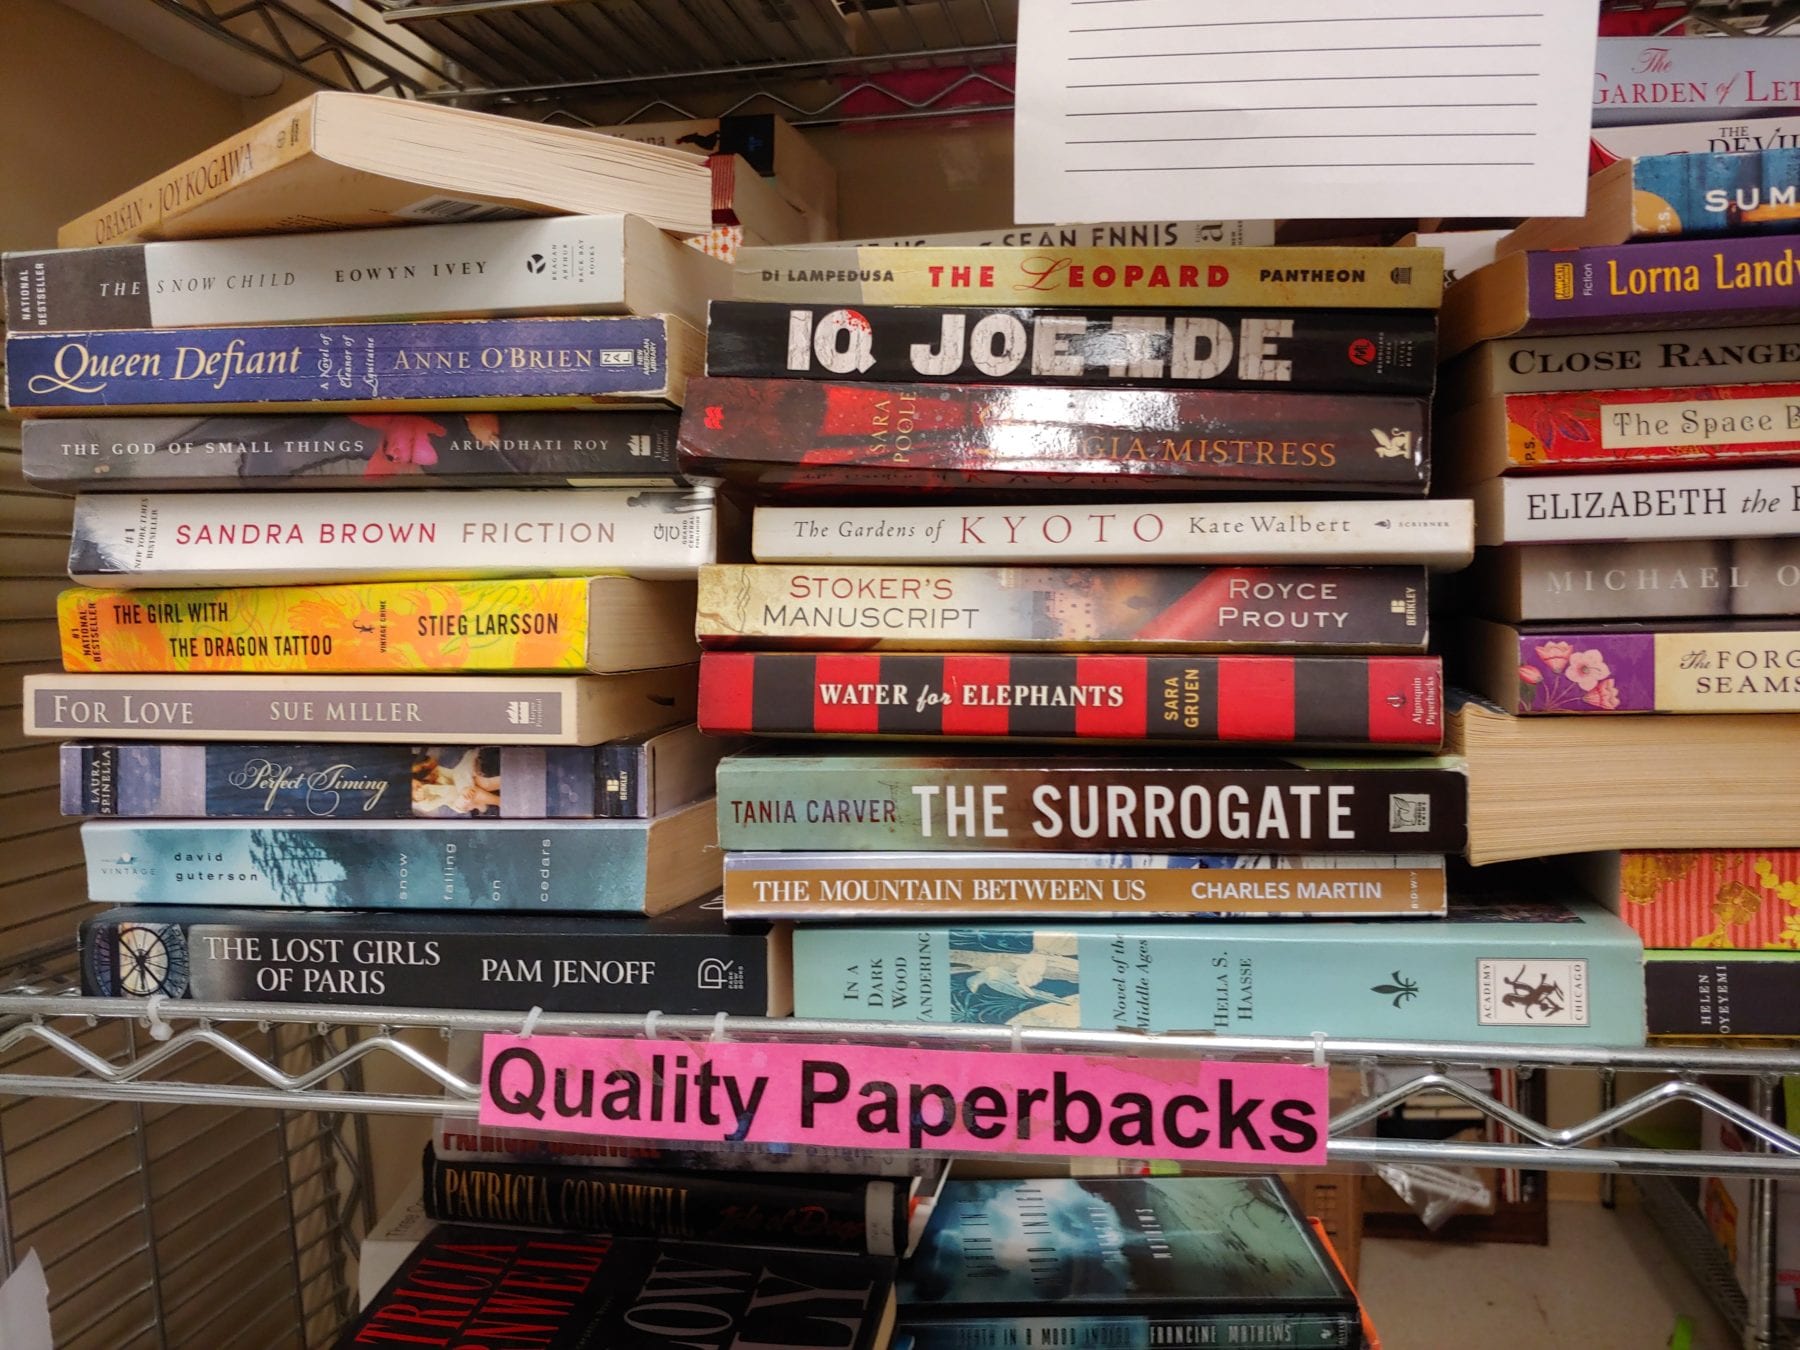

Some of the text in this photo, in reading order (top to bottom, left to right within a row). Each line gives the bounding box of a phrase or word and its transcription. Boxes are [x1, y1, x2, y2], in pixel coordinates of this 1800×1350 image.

[1632, 48, 1674, 74] The
[1716, 73, 1741, 105] of
[1719, 126, 1749, 138] THE
[95, 143, 254, 245] OBASAN JOY KOGAWA
[1704, 185, 1797, 212] SUM
[100, 271, 296, 297] THE SNOW CHILD
[335, 261, 489, 283] EOWYN IVEY
[788, 269, 895, 282] LAMPEDUSA
[928, 256, 1230, 292] THE LEOPARD
[1259, 269, 1366, 283] PANTHEON
[1582, 262, 1592, 297] Fiction
[1608, 259, 1700, 296] Lorna
[22, 268, 30, 321] NATIONAL
[37, 262, 46, 326] BESTSELLER
[393, 347, 593, 370] ANNE O'BRIEN
[786, 308, 877, 375] IQ
[909, 313, 1088, 378] JOE
[1508, 342, 1800, 375] CLOSE RANGE
[28, 339, 303, 394] Queen Defiant
[318, 333, 333, 390] A Novel of
[337, 334, 355, 388] Eleanor of
[362, 337, 378, 396] Aquitaine
[869, 399, 892, 456] SARA
[893, 391, 919, 464] POOLE
[1613, 408, 1773, 439] The Space
[61, 440, 365, 456] THE GOD OF SMALL THINGS
[450, 439, 610, 451] ARUNDHATI ROY
[1163, 438, 1337, 468] MISTRESS
[1524, 436, 1535, 461] P.S.
[1527, 487, 1727, 521] ELIZABETH
[1741, 489, 1780, 514] the
[135, 498, 149, 569] NEW YORK TIMES
[146, 508, 158, 559] BESTSELLER
[176, 522, 436, 545] SANDRA BROWN
[461, 522, 616, 543] FRICTION
[793, 512, 1165, 545] The Gardens of KYOTO
[1189, 514, 1352, 535] Kate Walbert
[1398, 520, 1451, 528] SCRIBNER
[789, 574, 954, 600] STOKER'S
[1229, 578, 1338, 601] ROYCE
[1549, 565, 1750, 593] MICHAEL
[113, 602, 229, 625] THE GIRL WITH
[763, 604, 980, 630] MANUSCRIPT
[1218, 606, 1349, 629] PROUTY
[1406, 586, 1417, 626] BERKLEY
[72, 627, 79, 640] #1
[80, 608, 90, 657] NATIONAL
[90, 602, 101, 663] BESTSELLER
[417, 613, 559, 637] STIEG LARSSON
[169, 635, 333, 658] THE DRAGON TATTOO
[1680, 649, 1711, 670] The
[53, 695, 194, 725] FOR LOVE
[269, 701, 424, 723] SUE MILLER
[819, 684, 1124, 713] WATER for ELEPHANTS
[1164, 676, 1179, 721] SARA
[1184, 669, 1199, 728] GRUEN
[1411, 676, 1424, 726] Algonquin
[1426, 675, 1436, 727] Paperbacks
[90, 759, 101, 803] LAURA
[101, 749, 112, 814] SPINELLA
[228, 758, 390, 816] Perfect Timing
[619, 770, 629, 801] BERKLEY
[731, 800, 896, 825] TANIA CARVER
[911, 785, 1009, 838] THE
[1031, 784, 1356, 840] SURROGATE
[101, 867, 158, 876] VINTAGE
[174, 852, 224, 863] david
[445, 843, 457, 901] falling
[540, 839, 551, 902] cedars
[176, 870, 259, 883] guterson
[399, 853, 409, 900] snow
[491, 878, 501, 902] on
[753, 878, 1147, 902] THE MOUNTAIN BETWEEN US
[1191, 882, 1382, 899] CHARLES MARTIN
[203, 936, 441, 966] THE LOST GIRLS
[256, 967, 386, 995] OF PARIS
[481, 958, 656, 988] PAM JENOFF
[843, 964, 859, 1001] IN A
[868, 958, 884, 1007] DARK
[892, 956, 908, 1009] WOOD
[917, 932, 933, 1022] ANDERING
[1112, 956, 1129, 1021] Novel of
[1135, 940, 1152, 1029] Middle Ages
[1211, 951, 1229, 1028] HELLA S.
[1237, 957, 1253, 1021] HAASSE
[1482, 963, 1492, 1019] ACADEMY
[1574, 963, 1583, 1021] CHICAGO
[1700, 974, 1711, 1025] HELEN
[1716, 965, 1731, 1034] OYEYEMI
[488, 1047, 1319, 1153] Quality Paperbacks
[444, 1168, 552, 1222] PATRICIA
[560, 1179, 694, 1236] CORNWELL
